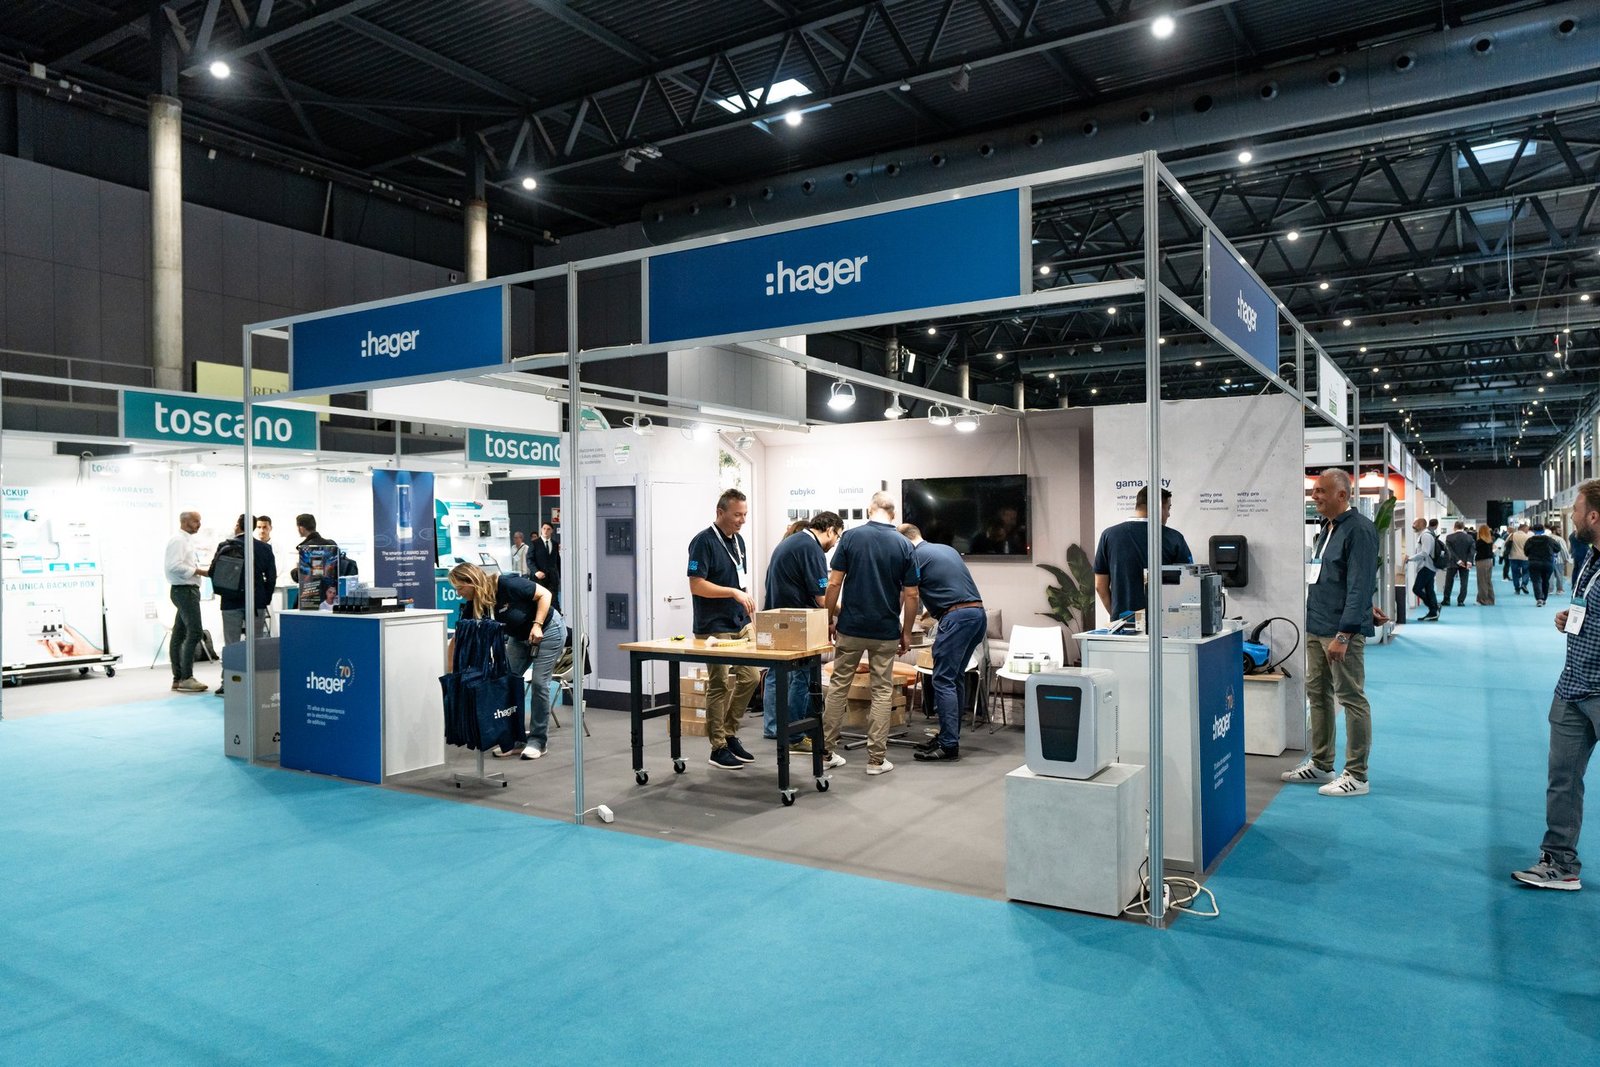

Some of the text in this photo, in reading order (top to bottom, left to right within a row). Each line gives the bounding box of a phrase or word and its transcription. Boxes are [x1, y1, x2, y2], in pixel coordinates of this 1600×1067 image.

[766, 256, 868, 295] :hager
[1237, 289, 1257, 333] :hager
[361, 329, 420, 358] :hager
[155, 401, 293, 442] toscano
[1, 488, 29, 497] ACKUP
[790, 488, 816, 497] cubyko
[1116, 480, 1143, 490] gama
[5, 583, 17, 591] LA
[339, 666, 351, 678] 70
[306, 671, 345, 695] :hager
[494, 706, 518, 719] :hager
[1212, 712, 1231, 741] :hager
